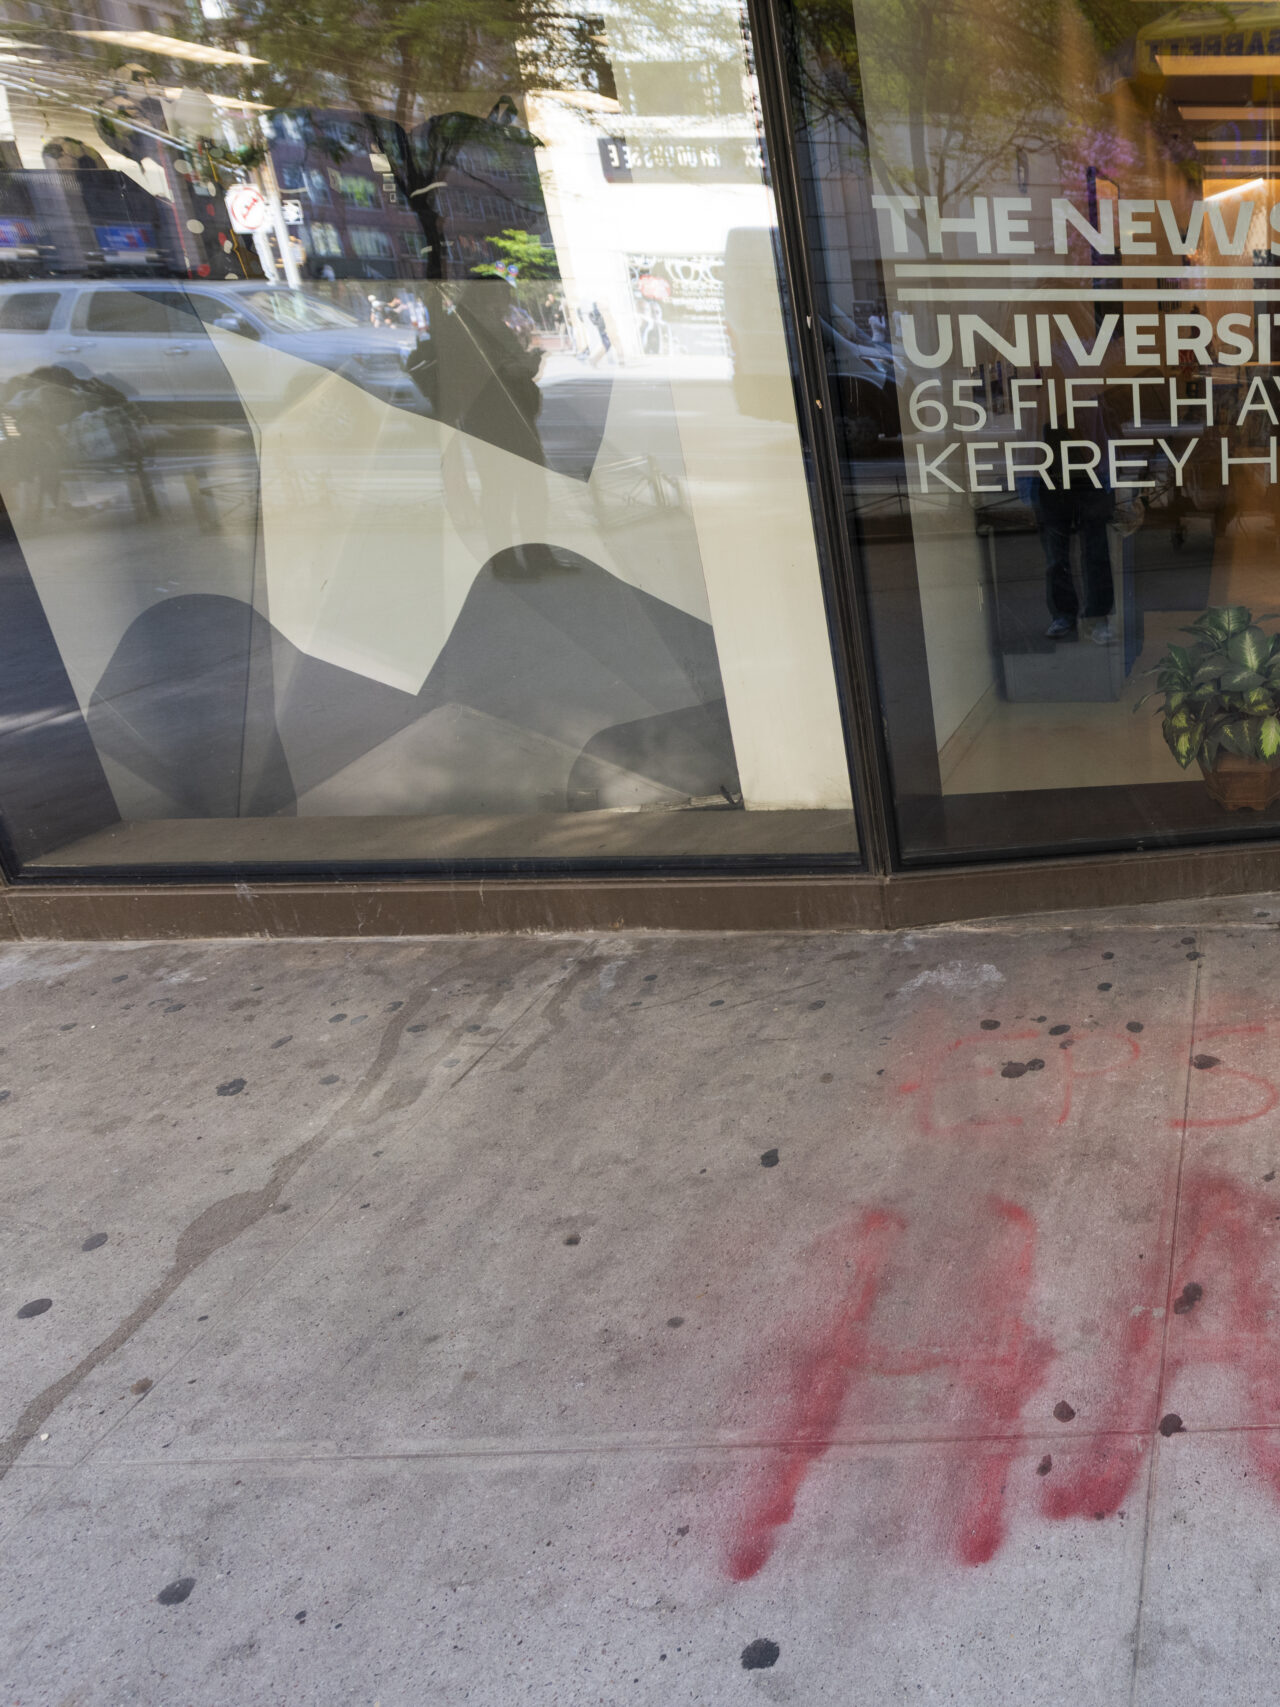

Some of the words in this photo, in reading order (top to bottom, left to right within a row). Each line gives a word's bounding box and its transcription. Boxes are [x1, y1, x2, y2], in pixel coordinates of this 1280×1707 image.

[871, 195, 1036, 254] THE
[1051, 198, 1256, 256] NEW
[909, 378, 987, 433] 65
[1011, 376, 1214, 430] FIFTH
[916, 437, 1199, 494] KERREY
